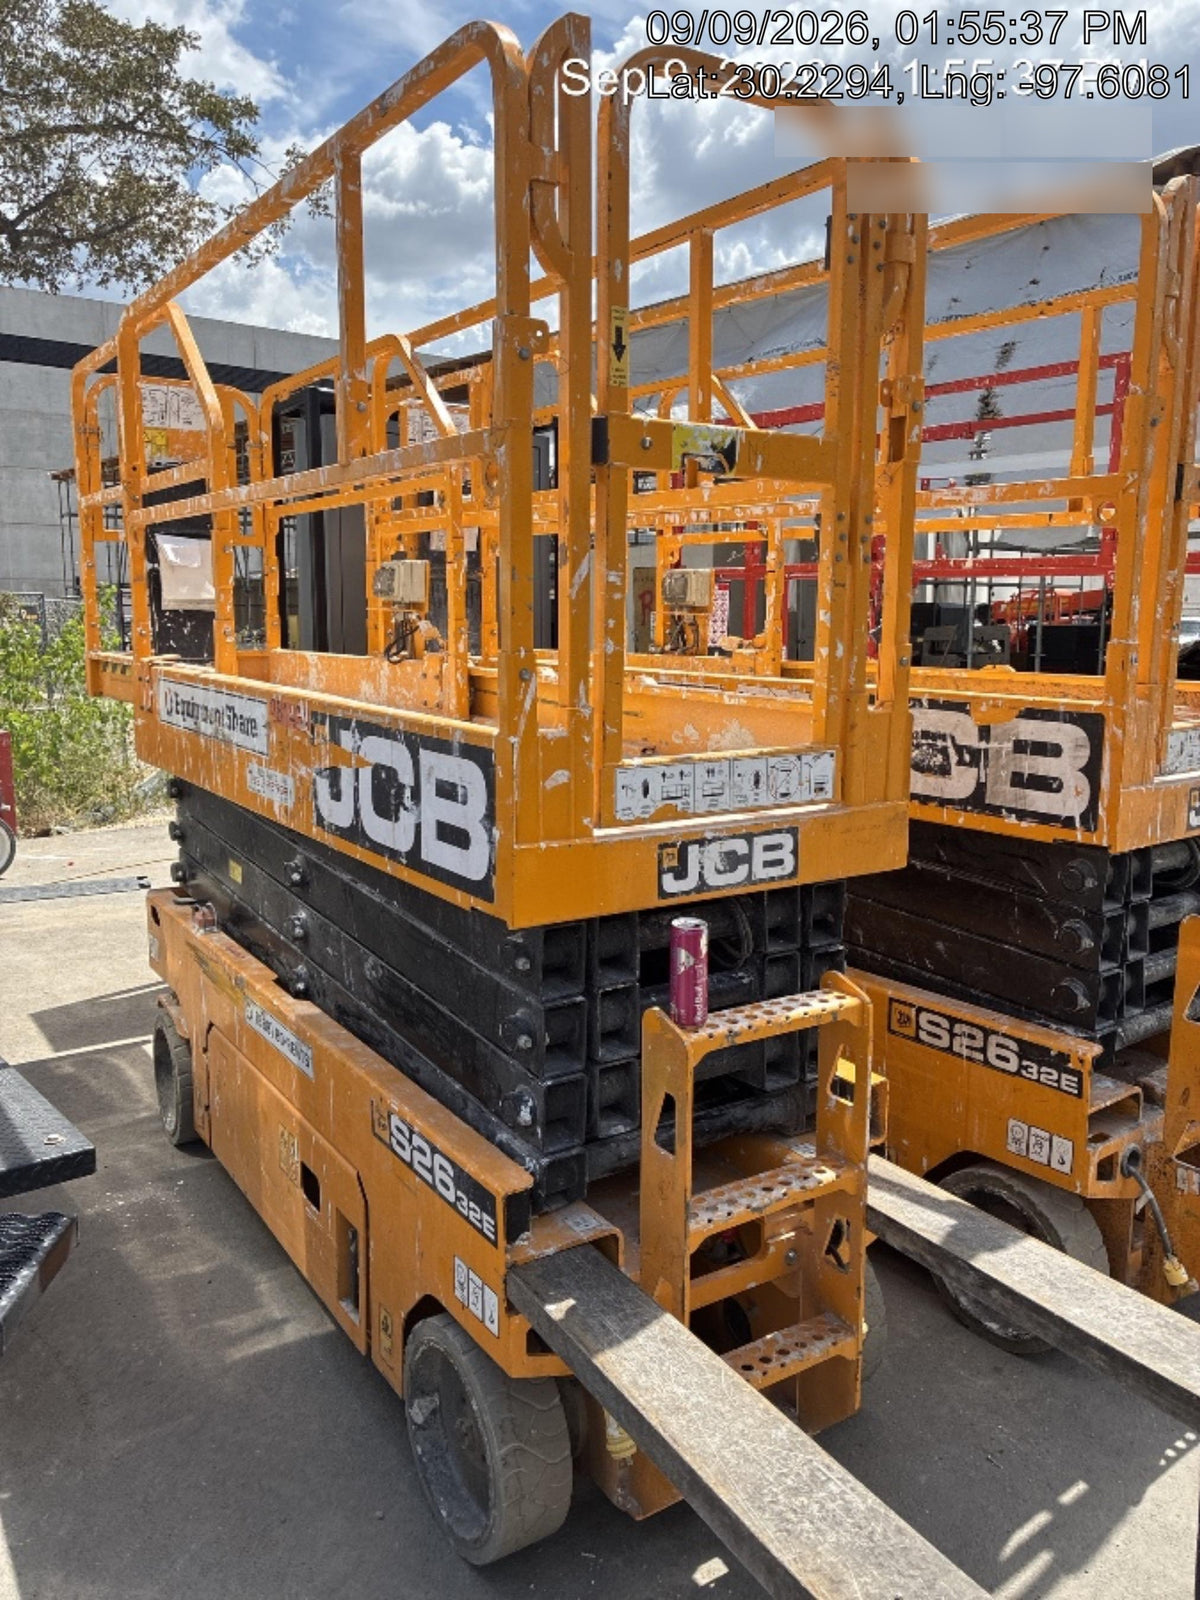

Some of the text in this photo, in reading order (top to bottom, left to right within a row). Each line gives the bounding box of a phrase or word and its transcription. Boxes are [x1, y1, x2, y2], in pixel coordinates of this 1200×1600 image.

[314, 729, 491, 881] JCB
[910, 707, 1091, 817] CB
[661, 832, 796, 894] JCB
